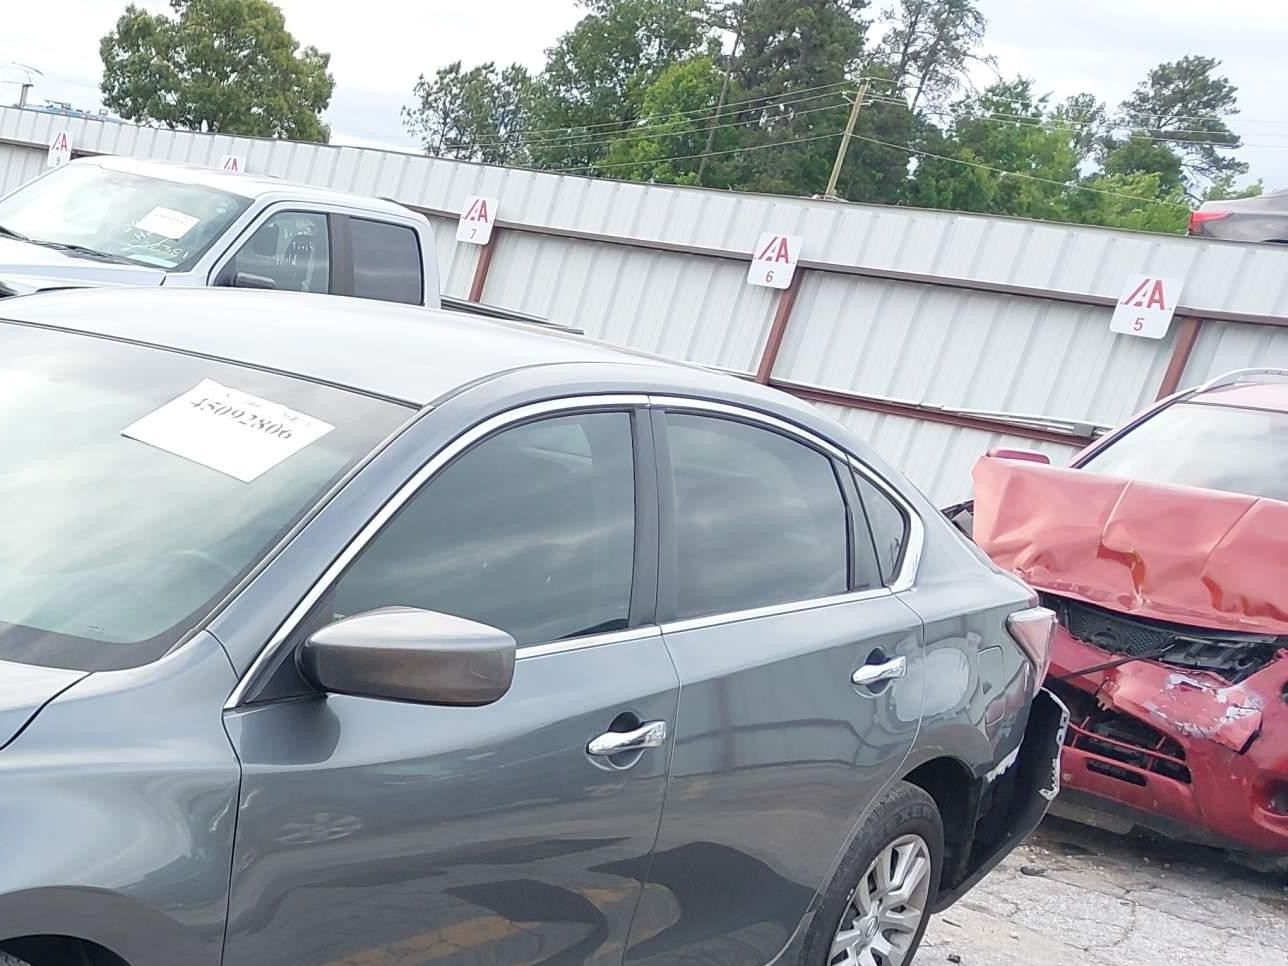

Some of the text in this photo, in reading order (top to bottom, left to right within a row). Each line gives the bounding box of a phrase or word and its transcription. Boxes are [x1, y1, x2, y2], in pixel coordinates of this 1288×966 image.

[470, 228, 477, 239] 7
[765, 270, 775, 283] 6
[1133, 317, 1145, 332] 5
[191, 397, 293, 440] 45092806
